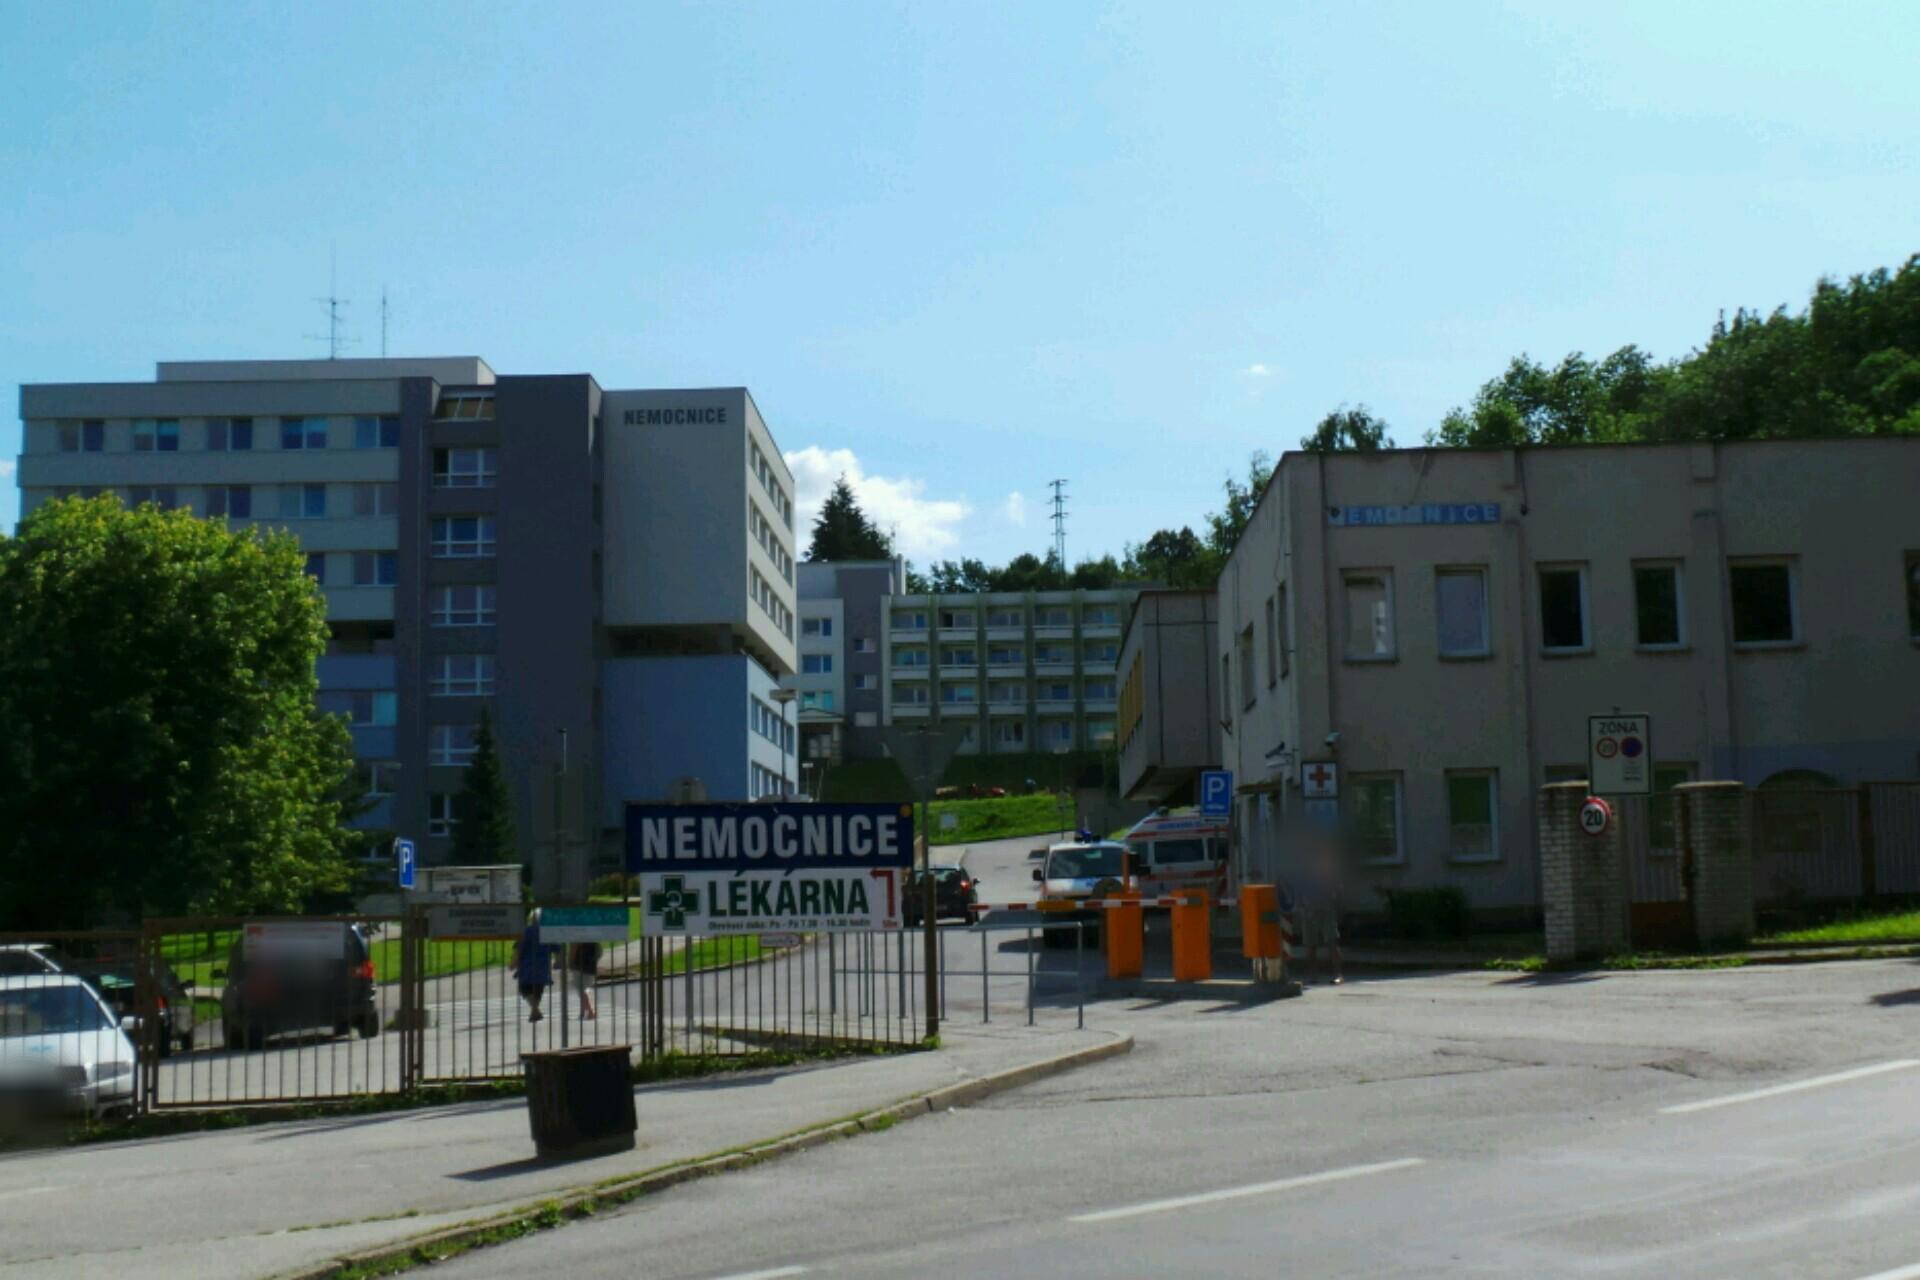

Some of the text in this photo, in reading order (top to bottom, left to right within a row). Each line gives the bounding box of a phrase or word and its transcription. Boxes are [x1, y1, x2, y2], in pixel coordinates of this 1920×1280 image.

[624, 408, 726, 425] NEMOCNICE
[1207, 776, 1225, 802] P
[1584, 809, 1603, 826] 20
[641, 814, 899, 859] NEMOCNICE
[402, 846, 411, 873] P
[708, 868, 869, 917] LÉKÁRNA
